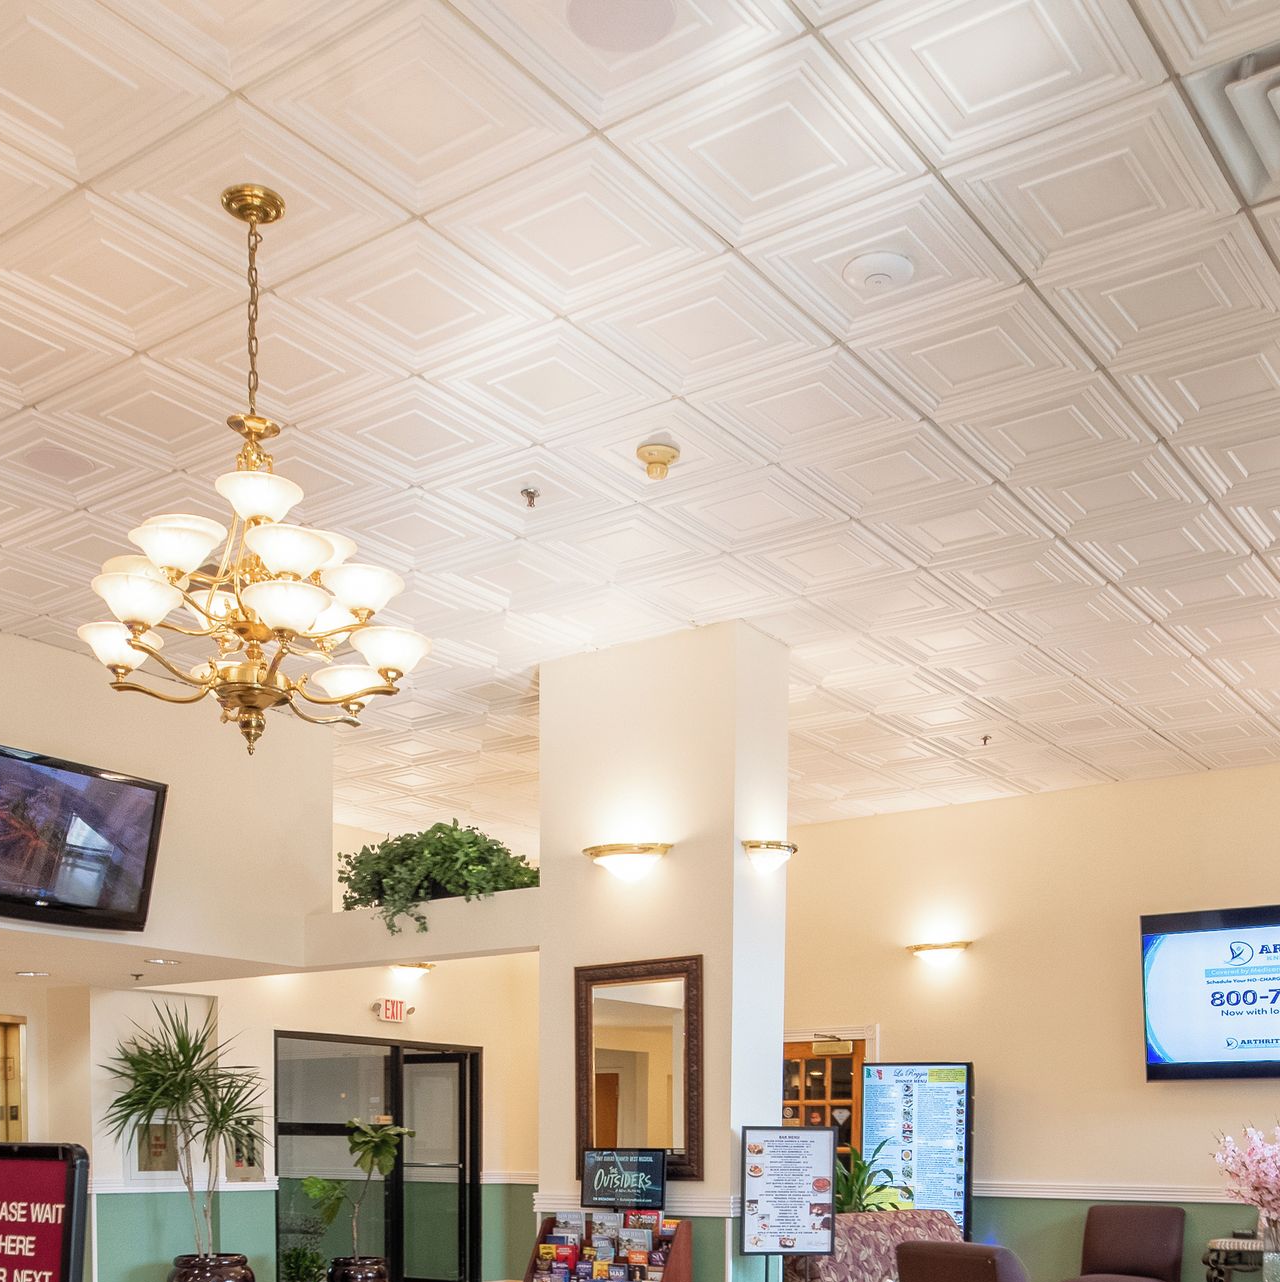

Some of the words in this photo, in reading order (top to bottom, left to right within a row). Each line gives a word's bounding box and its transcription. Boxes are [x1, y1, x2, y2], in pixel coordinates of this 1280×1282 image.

[384, 1000, 404, 1020] EXIT
[594, 1168, 652, 1191] OUTSIDERS
[30, 1203, 66, 1224] WAIT
